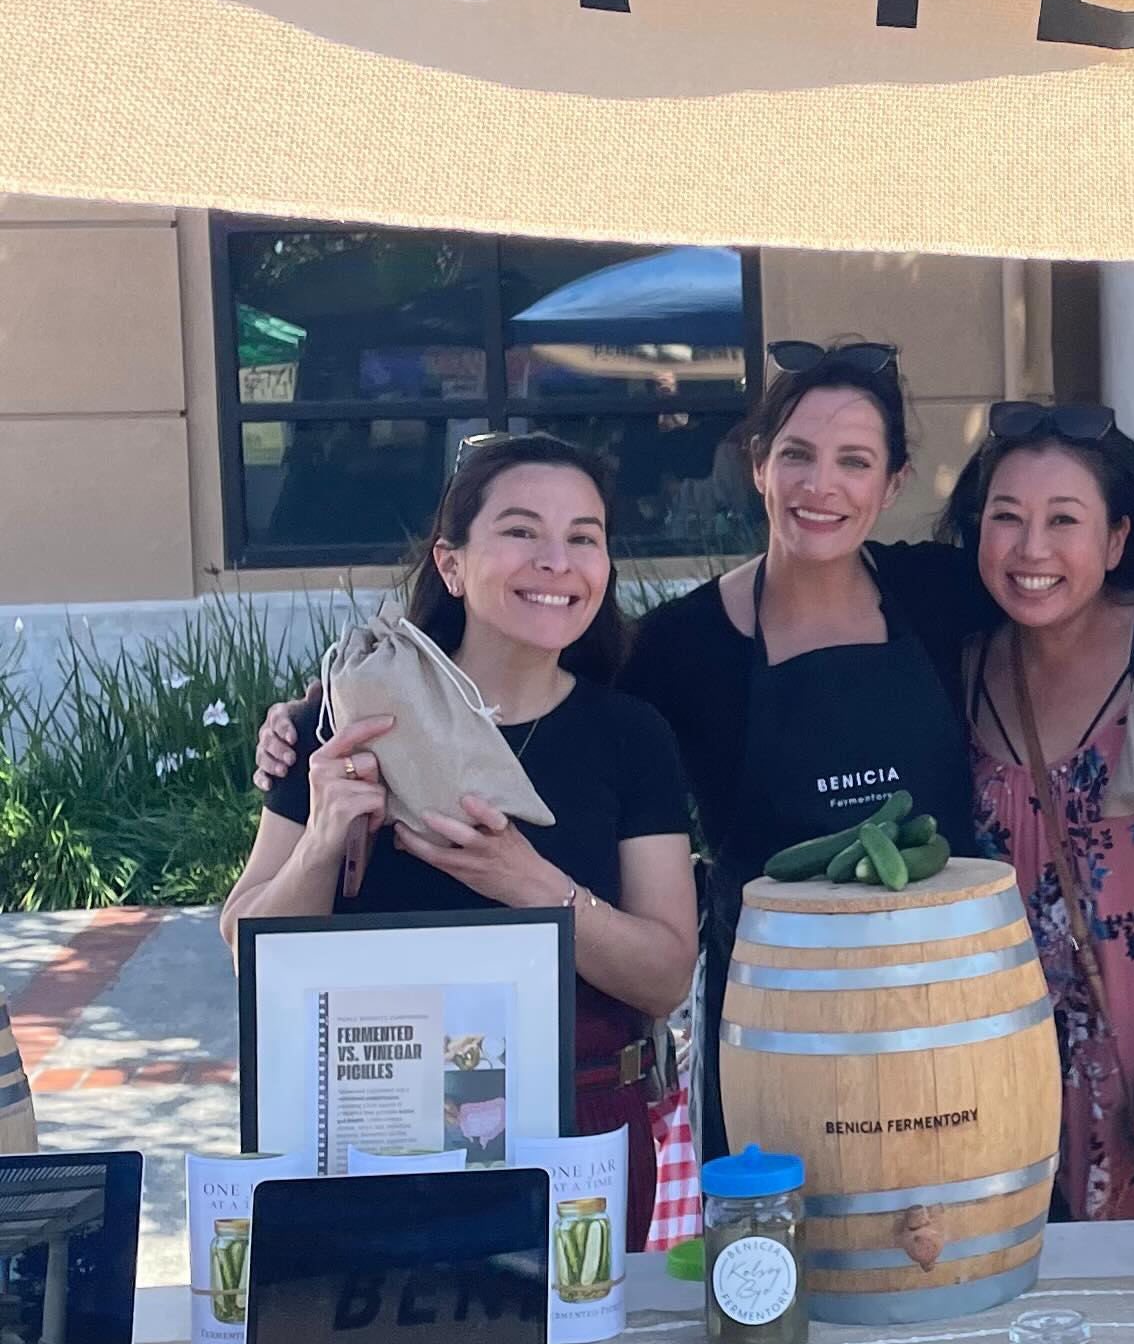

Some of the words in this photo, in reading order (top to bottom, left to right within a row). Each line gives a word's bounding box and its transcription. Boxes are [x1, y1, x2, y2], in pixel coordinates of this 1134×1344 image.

[816, 766, 900, 793] BENICIA
[337, 1025, 414, 1044] FERMENTED
[338, 1045, 360, 1062] VS.
[363, 1043, 422, 1061] VINEGAR
[337, 1062, 394, 1081] PICKLES
[825, 1120, 883, 1135] BENICIA
[887, 1107, 979, 1134] FERMENTORY
[589, 1158, 616, 1177] JAR
[203, 1183, 241, 1196] ONE
[727, 1240, 781, 1259] BENICIA
[720, 1287, 790, 1322] FERMENTORY
